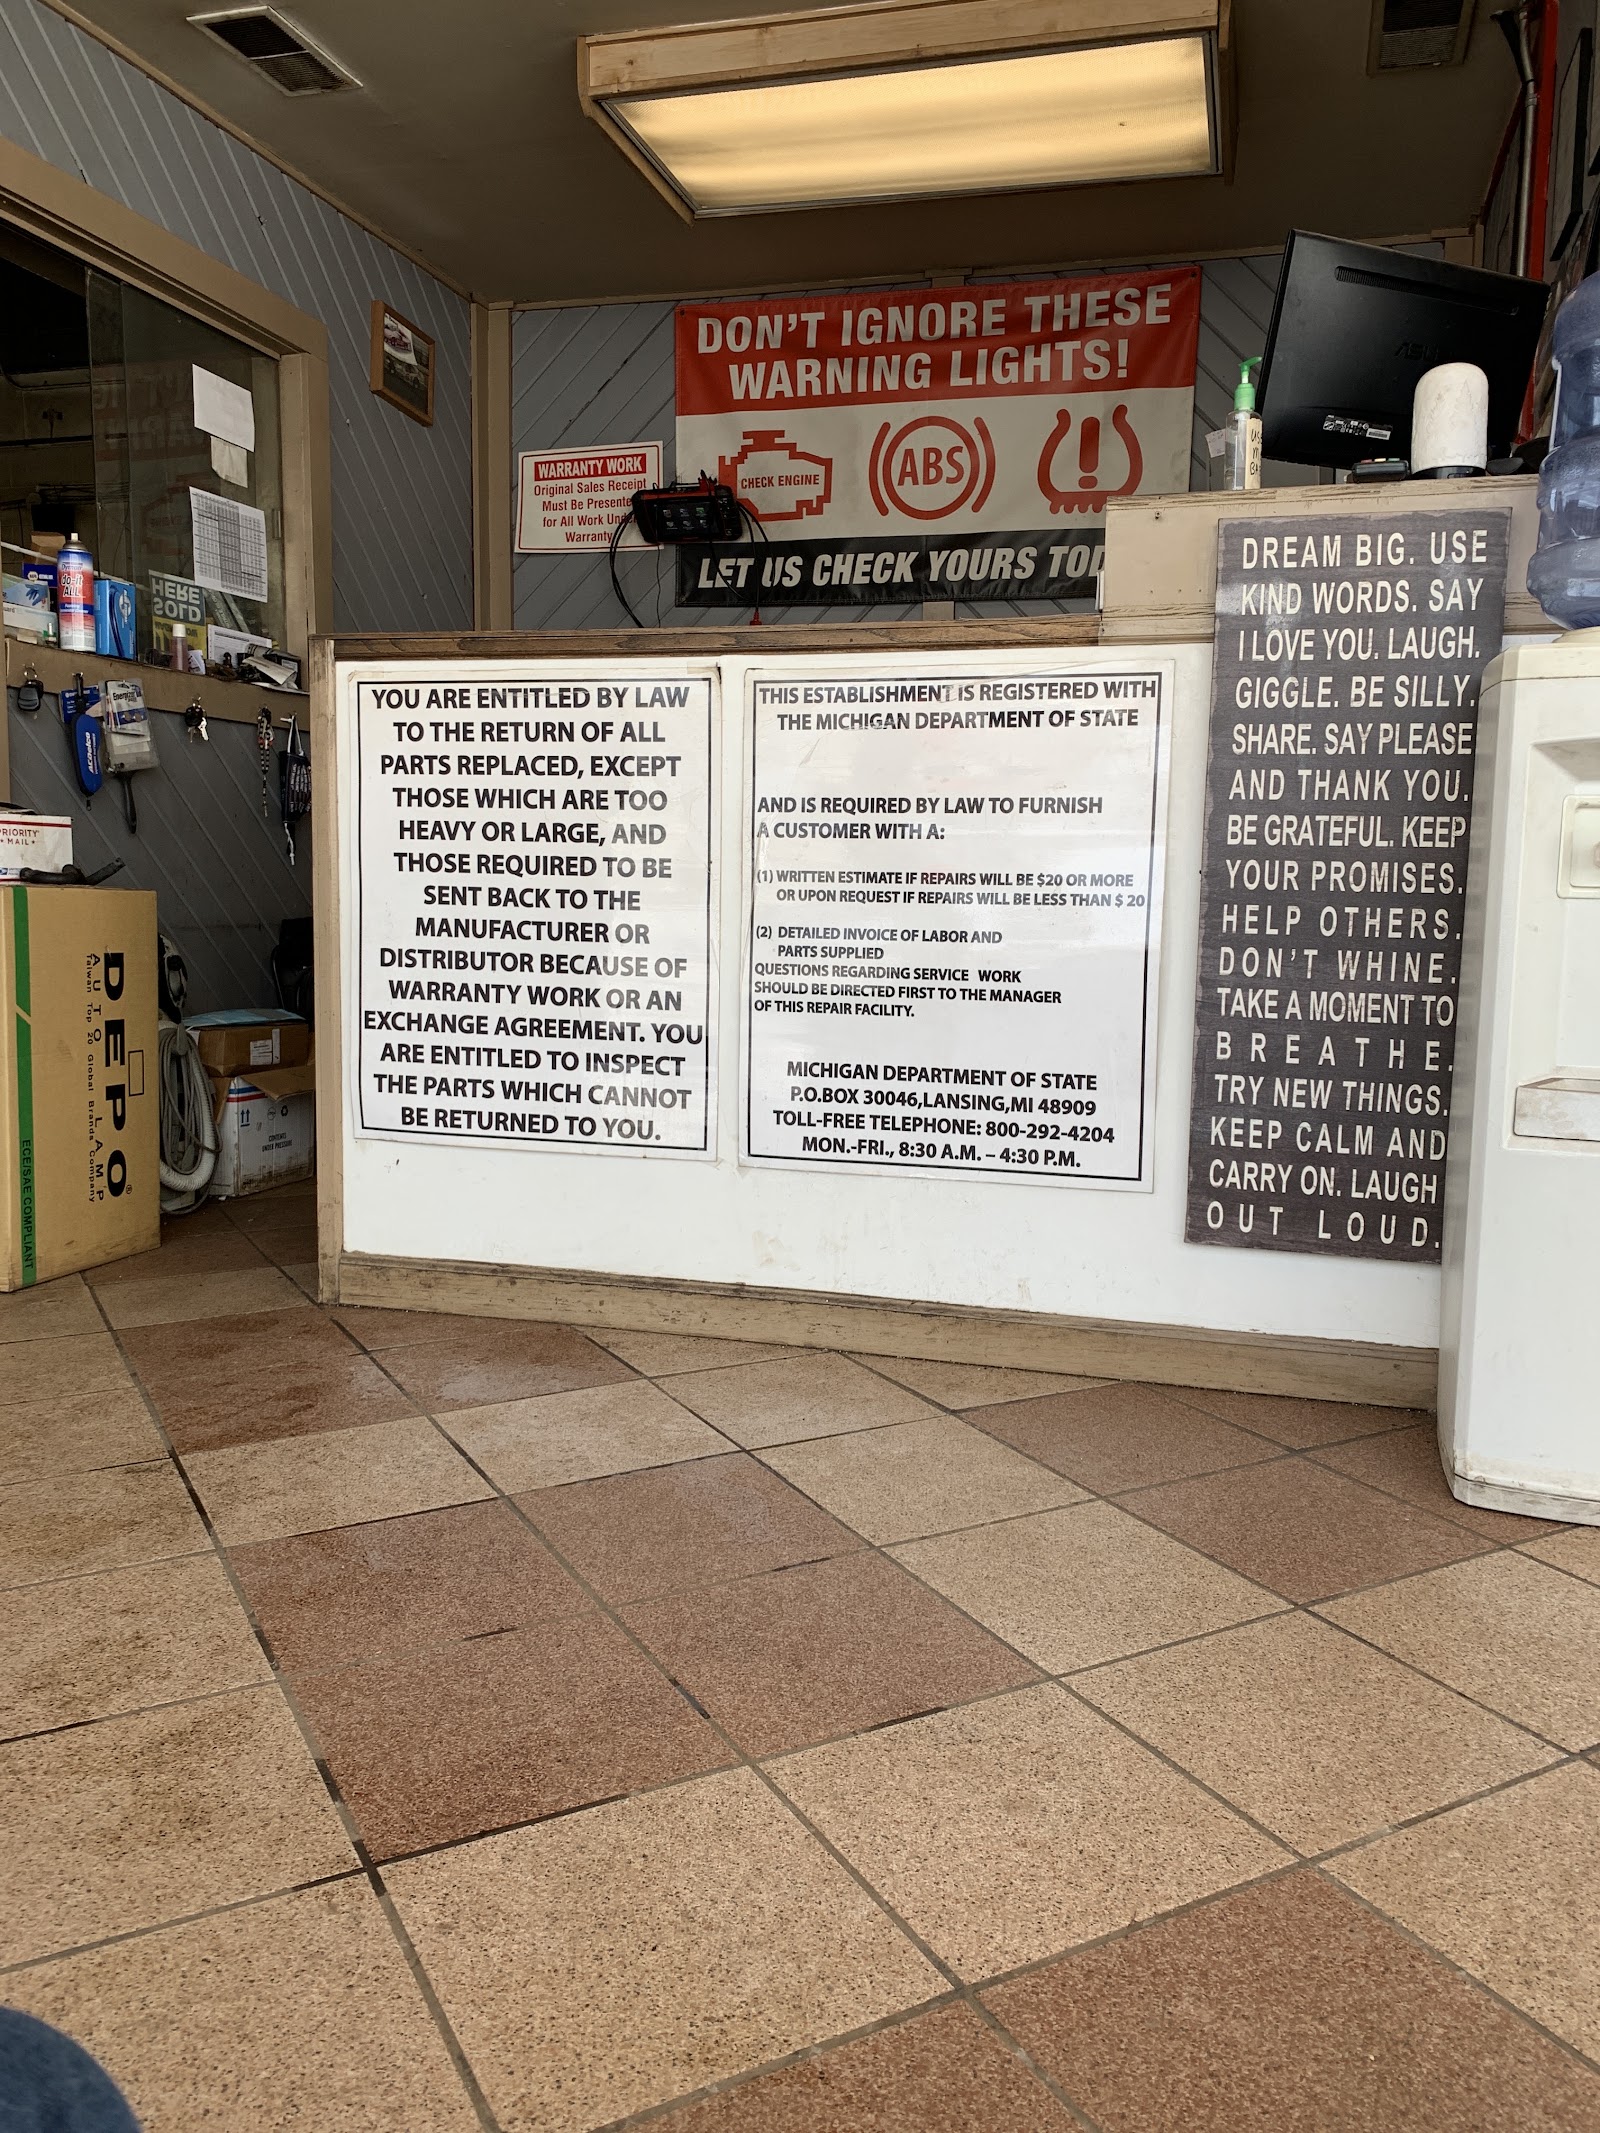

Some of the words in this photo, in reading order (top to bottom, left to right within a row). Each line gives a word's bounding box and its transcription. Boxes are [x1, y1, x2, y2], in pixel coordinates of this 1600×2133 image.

[698, 312, 825, 354] DON'T
[841, 299, 1007, 347] IGNORE
[1024, 284, 1172, 332] THESE
[729, 353, 931, 400] WARNING
[950, 339, 1129, 387] LIGHTS!
[538, 460, 605, 479] WARRANTY
[607, 456, 642, 473] WORK
[897, 446, 964, 486] ABS
[534, 481, 573, 497] Original
[577, 480, 605, 494] Sales
[608, 478, 647, 491] Receipt
[740, 475, 774, 489] CHECK
[776, 474, 820, 487] ENGINE
[542, 500, 567, 512] Must
[571, 499, 584, 510] Be
[587, 496, 632, 509] Presente
[542, 516, 556, 528] for
[560, 515, 574, 527] All
[577, 514, 604, 526] Work
[565, 531, 613, 544] Warranty
[1242, 534, 1341, 569] DREAM
[1355, 532, 1414, 566] BIG.
[1430, 529, 1487, 564] USE
[698, 556, 754, 589] LET
[763, 556, 802, 587] US
[812, 551, 919, 586] CHECK
[929, 548, 1038, 582] YOURS
[1048, 545, 1105, 578] TOD
[1238, 630, 1244, 661] I
[1251, 629, 1315, 661] LOVE
[1322, 627, 1379, 661] YOU.
[1387, 625, 1480, 659] LAUGH.
[113, 690, 136, 701] Energizer
[371, 688, 420, 709] YOU
[425, 688, 471, 709] ARE
[477, 687, 590, 709] ENTITLED
[596, 686, 629, 708] BY
[635, 686, 690, 708] LAW
[759, 687, 799, 705] THIS
[803, 684, 957, 704] ESTABLISHMENT
[957, 684, 975, 702] IS
[979, 681, 1099, 701] REGISTERED
[1102, 680, 1156, 699] WITH
[392, 721, 424, 742] TO
[429, 721, 475, 742] THE
[480, 721, 575, 743] RETURN
[580, 721, 614, 743] OF
[619, 721, 666, 742] ALL
[1231, 723, 1316, 755] SHARE.
[1324, 722, 1373, 755] SAY
[1378, 722, 1473, 755] PLEASE
[380, 754, 451, 775] PARTS
[457, 754, 584, 779] REPLACED,
[590, 755, 682, 777] EXCEPT
[0, 828, 38, 837] RIORITY
[399, 819, 477, 841] HEAVY
[481, 821, 516, 842] OR
[521, 821, 606, 847] LARGE,
[611, 823, 667, 845] AND
[1226, 814, 1258, 845] BE
[1264, 814, 1394, 847] GRATEFUL.
[1401, 815, 1466, 848] KEEP
[757, 869, 773, 884] (1)
[775, 869, 835, 883] WRITTEN
[837, 870, 903, 884] ESTIMATE
[905, 871, 918, 885] IF
[920, 872, 976, 886] REPAIRS
[978, 872, 1013, 886] WILL
[1015, 873, 1034, 886] BE
[1036, 872, 1063, 888] $20
[1065, 873, 1087, 887] OR
[1089, 873, 1133, 887] MORE
[423, 884, 482, 906] SENT
[487, 886, 551, 909] BACK
[554, 888, 588, 910] TO
[592, 889, 641, 911] THE
[415, 916, 610, 943] MANUFACTURER
[614, 923, 650, 944] OR
[756, 925, 772, 940] (2)
[777, 926, 841, 940] DETAILED
[843, 927, 898, 941] INVOICE
[900, 928, 919, 942] OF
[921, 929, 968, 943] LABOR
[970, 930, 1003, 944] AND
[379, 947, 534, 973] DISTRIBUTOR
[540, 953, 648, 977] BECAUSE
[654, 957, 687, 978] OF
[777, 944, 818, 958] PARTS
[819, 945, 884, 960] SUPPLIED
[1219, 946, 1318, 979] DON'T
[1337, 949, 1456, 984] WHINE.
[92, 953, 102, 1042] AUTO
[755, 980, 808, 995] SHOULD
[811, 982, 828, 995] BE
[830, 983, 896, 998] DIRECTED
[898, 985, 936, 999] FIRST
[937, 987, 957, 1000] TO
[959, 987, 987, 1001] THE
[989, 988, 1062, 1004] MANAGER
[755, 999, 772, 1012] OF
[773, 999, 804, 1013] THIS
[806, 1001, 852, 1015] REPAIR
[854, 1002, 915, 1017] FACILITY.
[1216, 987, 1279, 1019] TAKE
[1284, 990, 1302, 1020] A
[1309, 990, 1415, 1025] MOMENT
[1421, 994, 1454, 1026] TO
[87, 1032, 93, 1045] 20
[365, 1010, 489, 1035] EXCHANGE
[493, 1016, 646, 1043] AGREEMENT.
[650, 1022, 703, 1045] YOU
[104, 952, 127, 1197] DEPO
[786, 1060, 878, 1080] MICHIGAN
[882, 1064, 1007, 1087] DEPARTMENT
[1010, 1070, 1036, 1088] OF
[1040, 1072, 1097, 1091] STATE
[269, 1133, 287, 1142] CONTENTS
[772, 1109, 866, 1130] TOLL-FREE
[869, 1114, 982, 1136] TELEPHONE:
[985, 1120, 1115, 1143] 800-292-4204
[1210, 1115, 1282, 1149] KEEP
[1295, 1121, 1373, 1155] CALM
[1386, 1127, 1445, 1160] AND
[94, 1116, 104, 1201] LAMP
[262, 1144, 274, 1152] UNDER
[22, 1139, 31, 1194] ECE/SAE
[1209, 1158, 1293, 1193] CARRY
[1300, 1165, 1341, 1197] ON.
[1350, 1168, 1437, 1204] LAUGH
[23, 1197, 34, 1269] COMPLIANT
